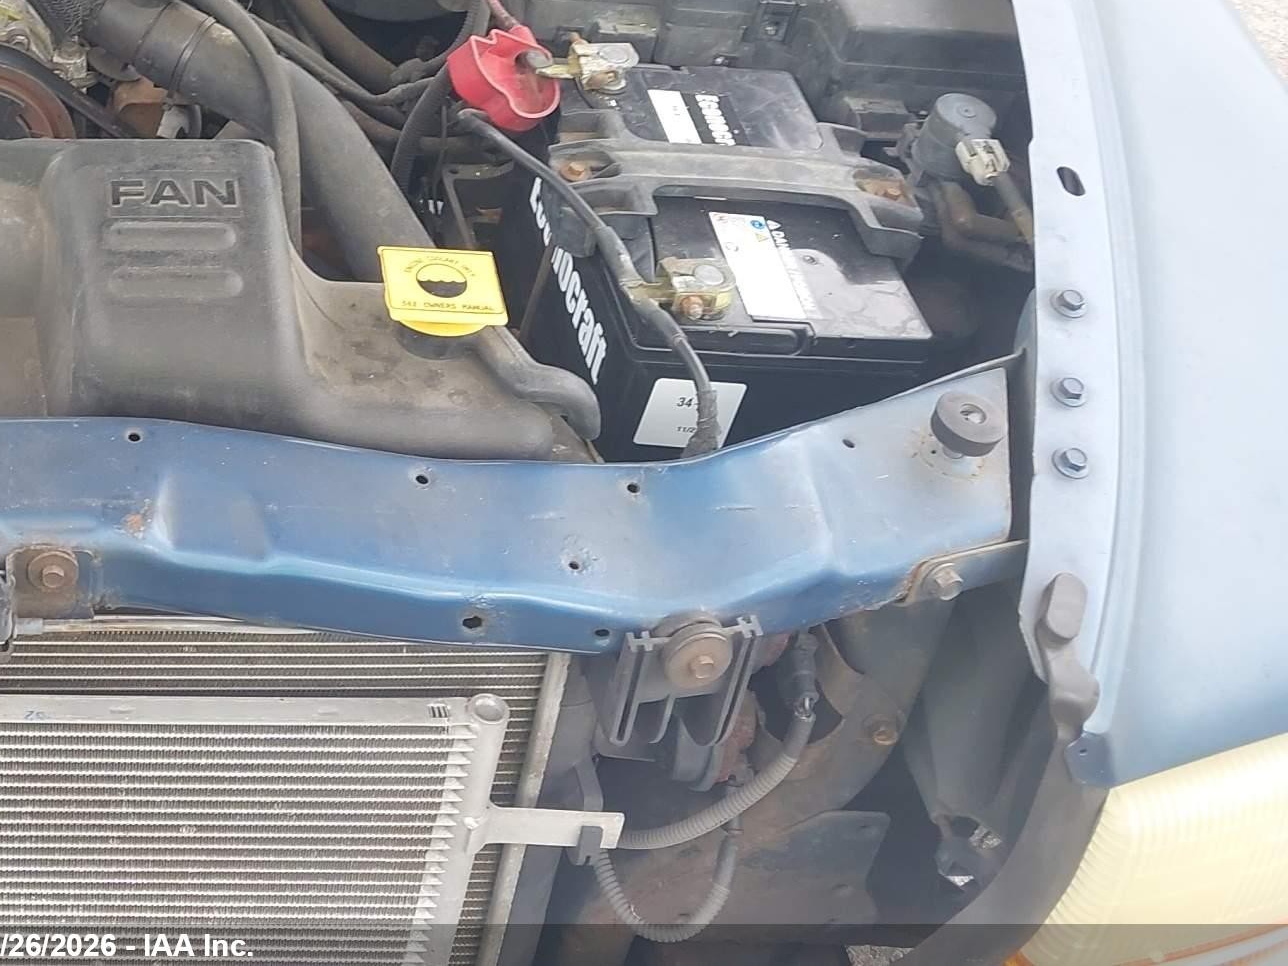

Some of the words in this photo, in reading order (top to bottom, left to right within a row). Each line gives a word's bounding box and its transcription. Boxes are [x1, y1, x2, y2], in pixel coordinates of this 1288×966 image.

[694, 94, 736, 146] Econocr
[109, 178, 241, 207] FAN
[676, 397, 700, 408] 34-
